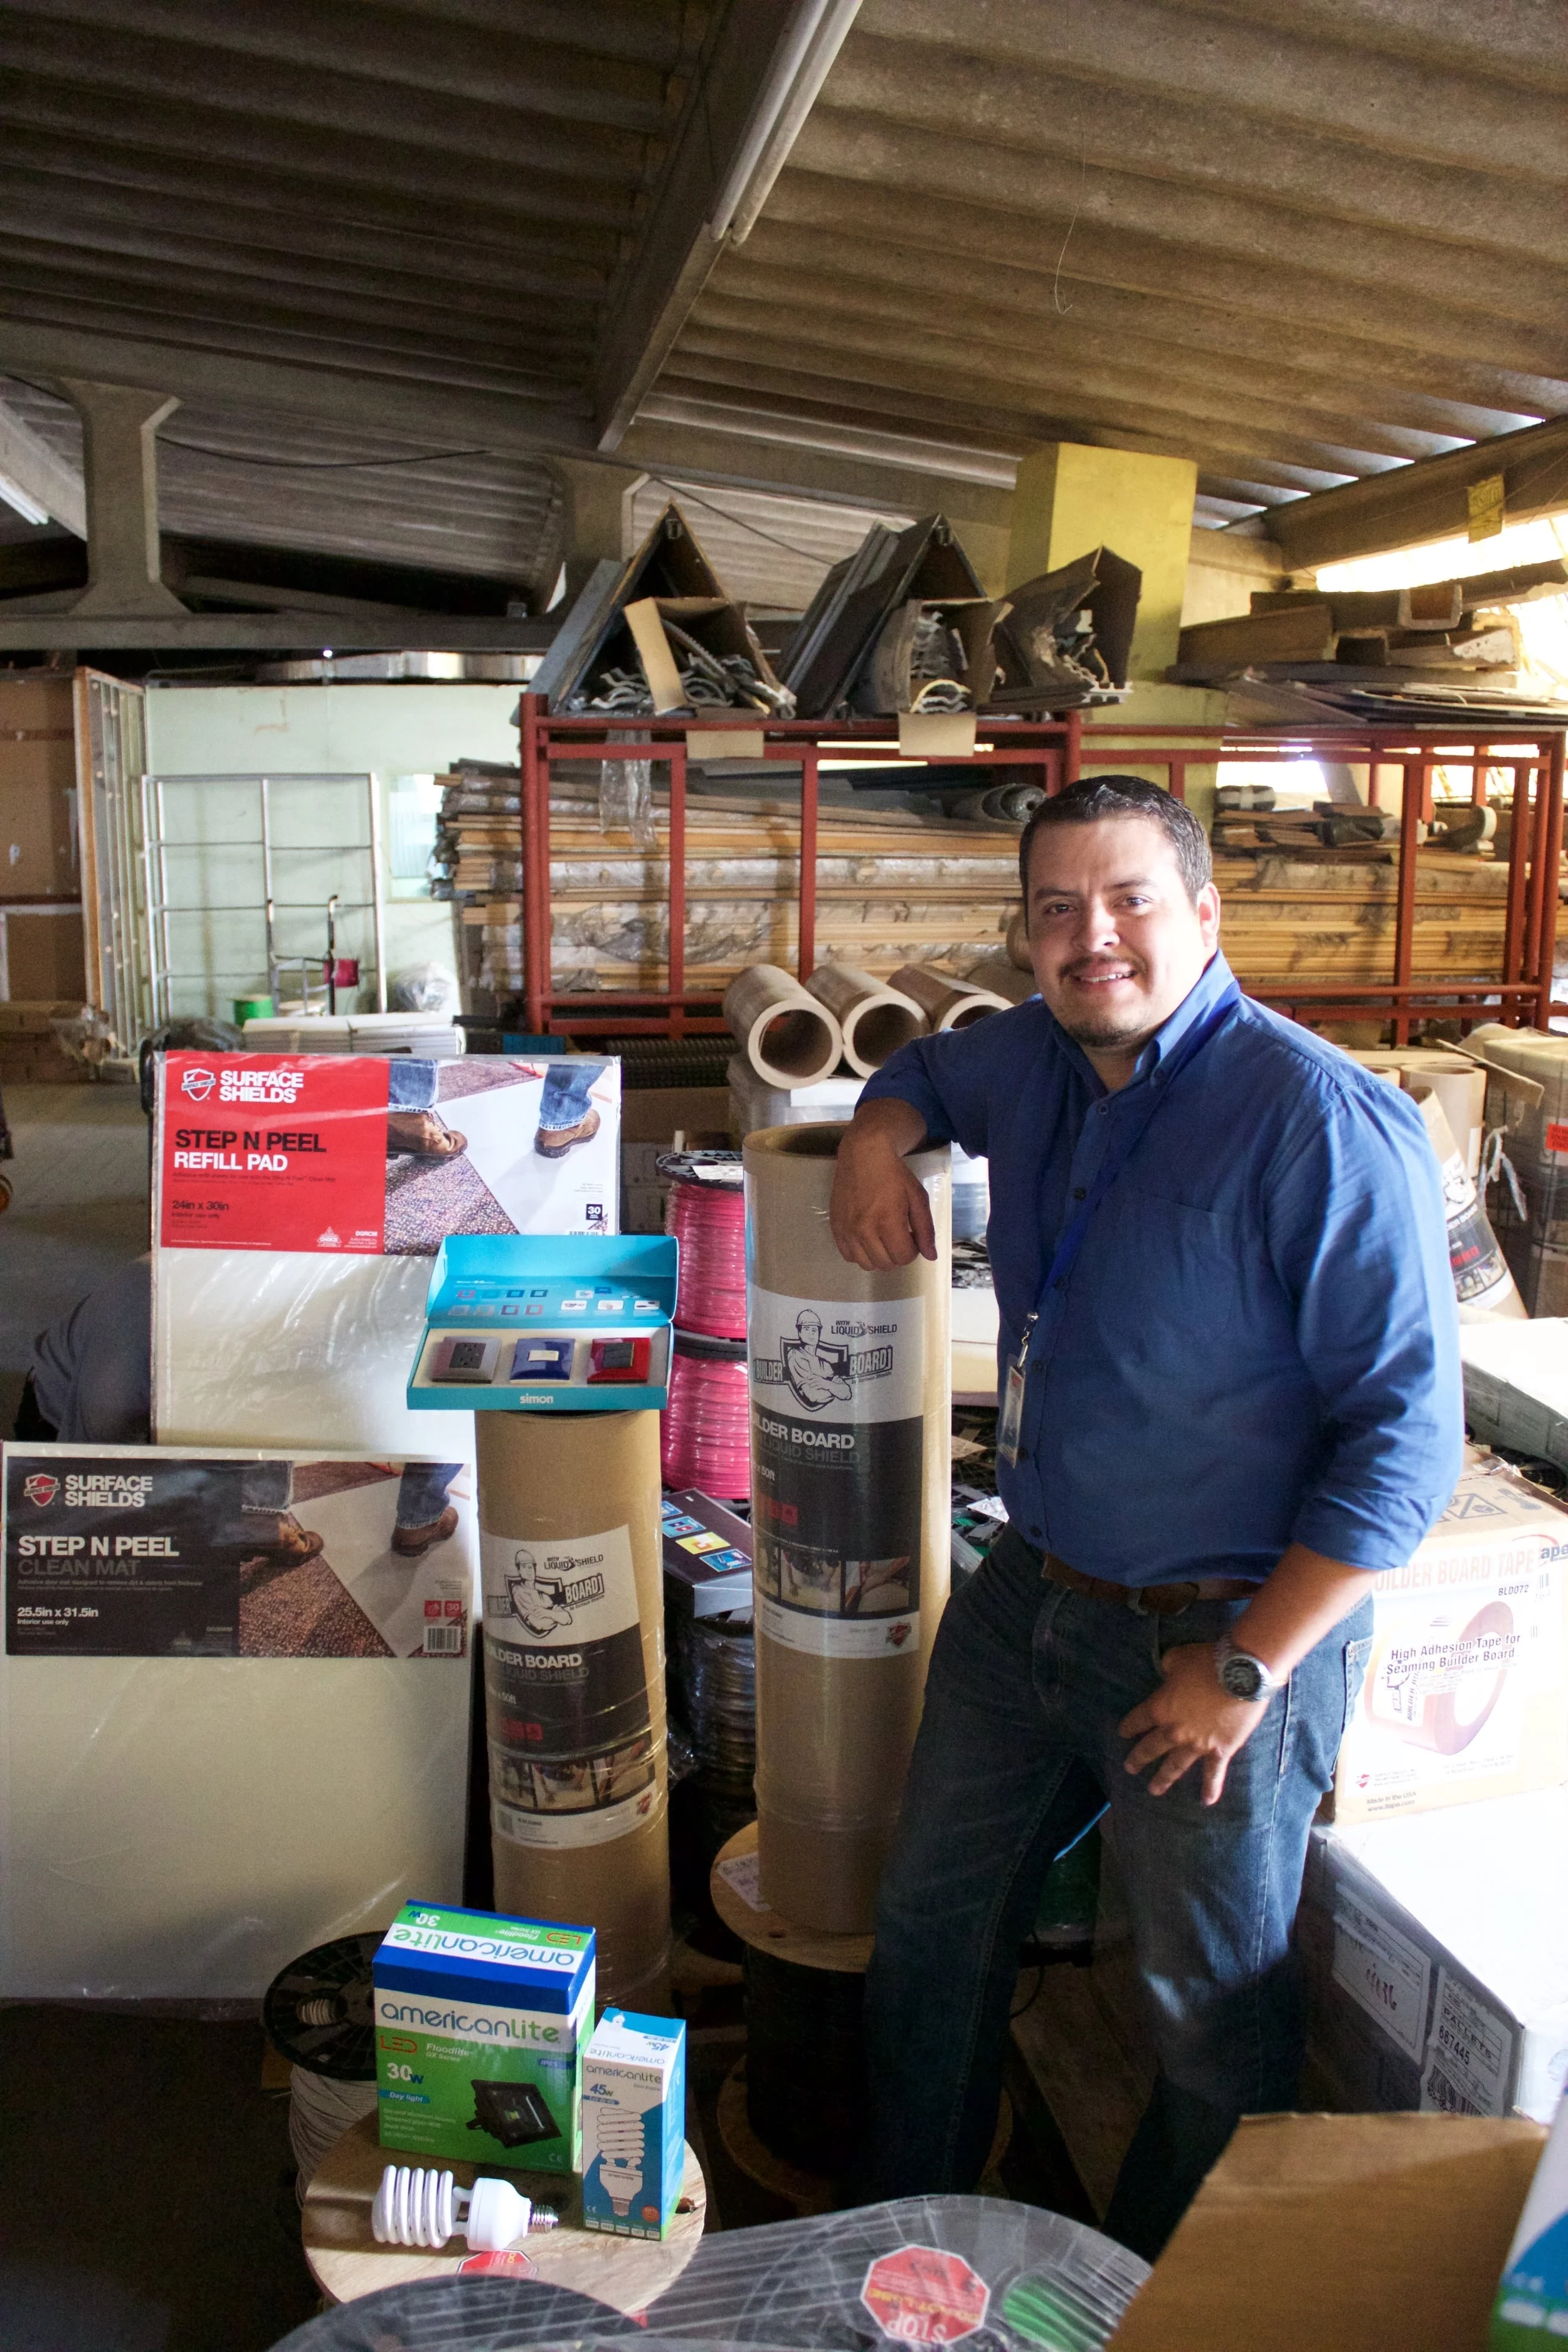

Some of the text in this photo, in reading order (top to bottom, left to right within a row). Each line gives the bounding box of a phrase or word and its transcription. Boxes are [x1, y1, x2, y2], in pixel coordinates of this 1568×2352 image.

[220, 1071, 304, 1088] SURFACE
[220, 1086, 297, 1103] SHIELDS
[176, 1129, 327, 1152] STEP N PEEL
[174, 1152, 288, 1171] REFILL PAD
[588, 1206, 601, 1214] 30
[831, 1325, 898, 1335] LIQUID SHIELD
[850, 1348, 887, 1376] BOARD
[520, 1393, 554, 1404] simon
[792, 1428, 855, 1449] BOARD
[65, 1475, 152, 1491] SURFACE
[65, 1491, 146, 1508] SHIELDS
[18, 1535, 179, 1557] STEP N PEEL
[1540, 1544, 1568, 1562] ape
[18, 1559, 140, 1576] CLEAN MAT
[544, 1554, 603, 1569] LIQUID SHIELD
[1375, 1549, 1535, 1592] UILDER BOARD TAPE
[565, 1577, 598, 1604] BOARD
[1498, 1584, 1529, 1596] BLD072
[17, 1607, 52, 1617] 25.5in
[63, 1608, 98, 1618] 31.5in
[1391, 1634, 1520, 1661] High Adhesion Tape for
[525, 1653, 583, 1668] BOARD
[1387, 1660, 1435, 1675] Seaming
[1439, 1654, 1478, 1668] Builder
[1483, 1648, 1515, 1661] Board
[393, 1928, 575, 1966] americanlite
[546, 1932, 581, 1946] LED
[381, 2003, 560, 2042] americanlite
[379, 2035, 418, 2054] LED
[590, 2048, 665, 2065] americanlite
[586, 2065, 662, 2084] americanlite
[389, 2092, 423, 2102] Day light
[885, 2311, 947, 2344] STOP
